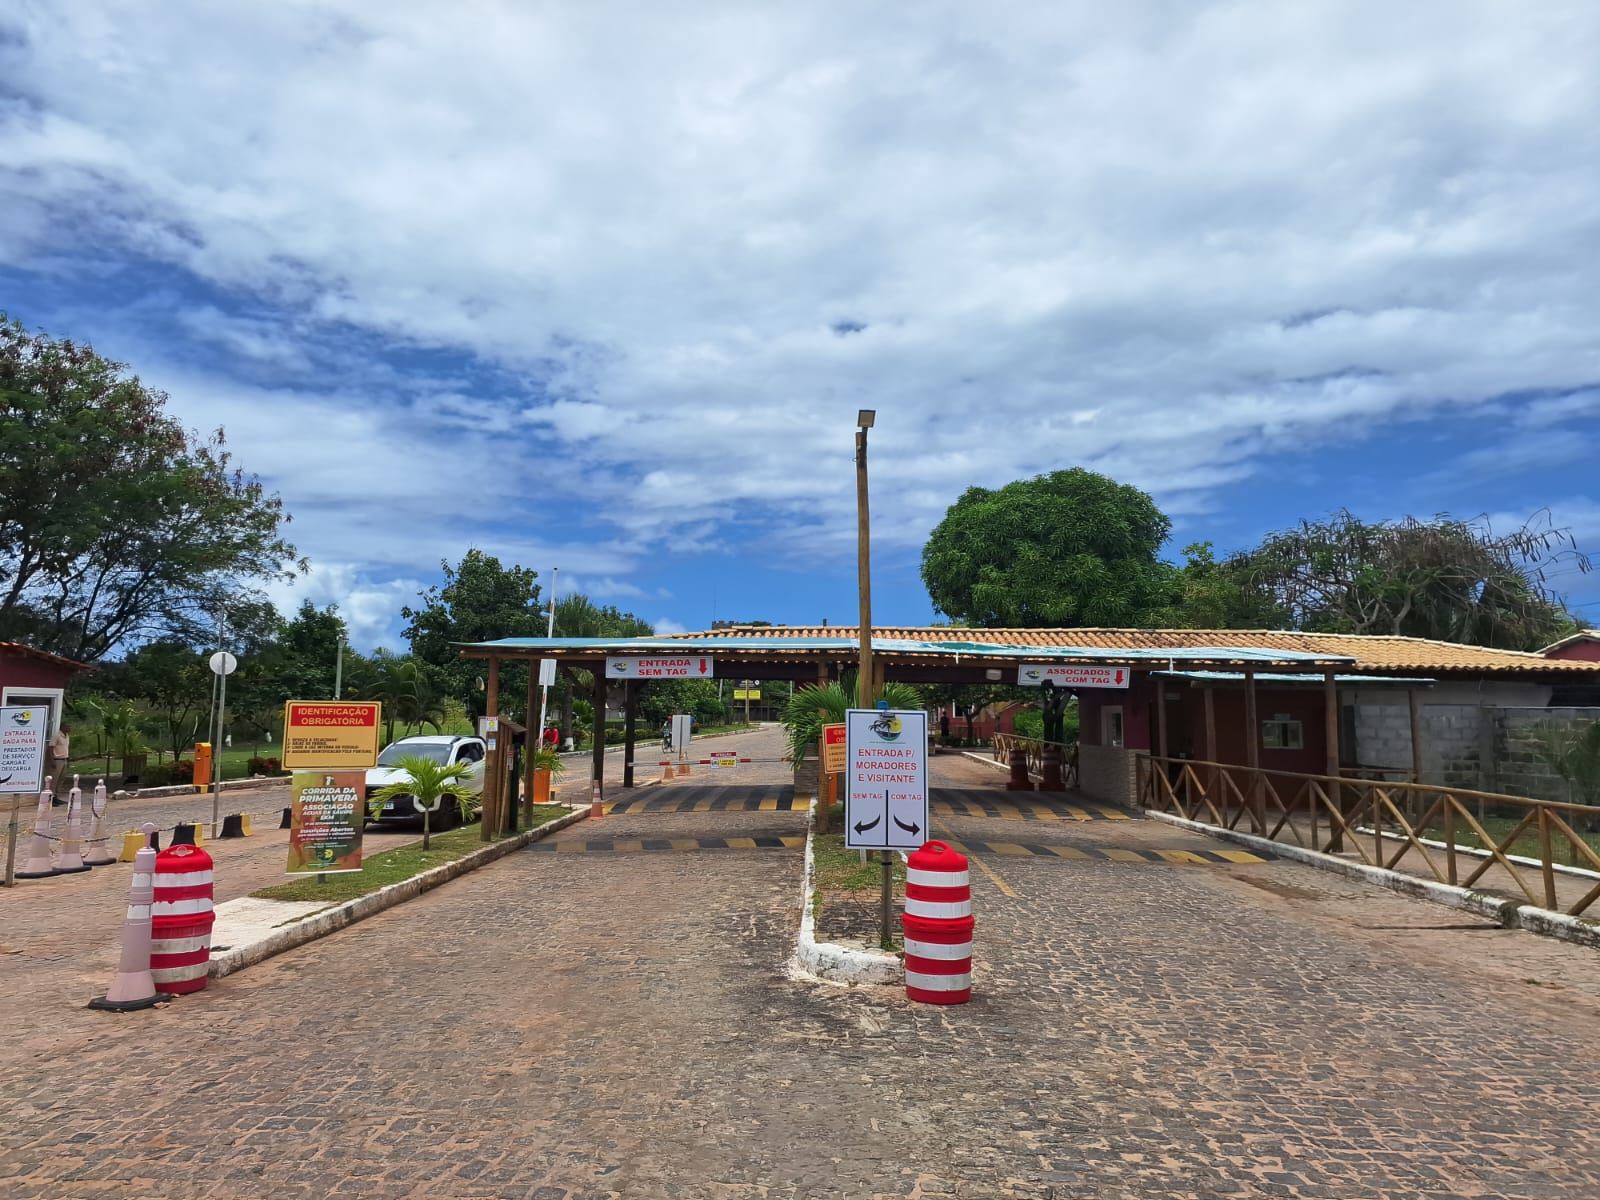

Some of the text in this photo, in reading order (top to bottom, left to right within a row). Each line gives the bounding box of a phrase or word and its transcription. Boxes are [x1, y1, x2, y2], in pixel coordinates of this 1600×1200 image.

[638, 659, 691, 667] ENTRADA
[638, 668, 662, 676] SEM
[1046, 668, 1111, 676] ASSOCIADOS
[298, 707, 369, 716] IDENTIFICAÇÃO
[301, 717, 364, 725] OBRIGATÓRIA
[858, 748, 915, 758] ENTRADA P/
[855, 761, 917, 771] MORADORES
[858, 773, 915, 783] E VISITANTE
[302, 787, 341, 795] CORRIDA
[299, 794, 358, 803] PRIMAVERA
[302, 802, 354, 811] ASSOCIAÇÃO
